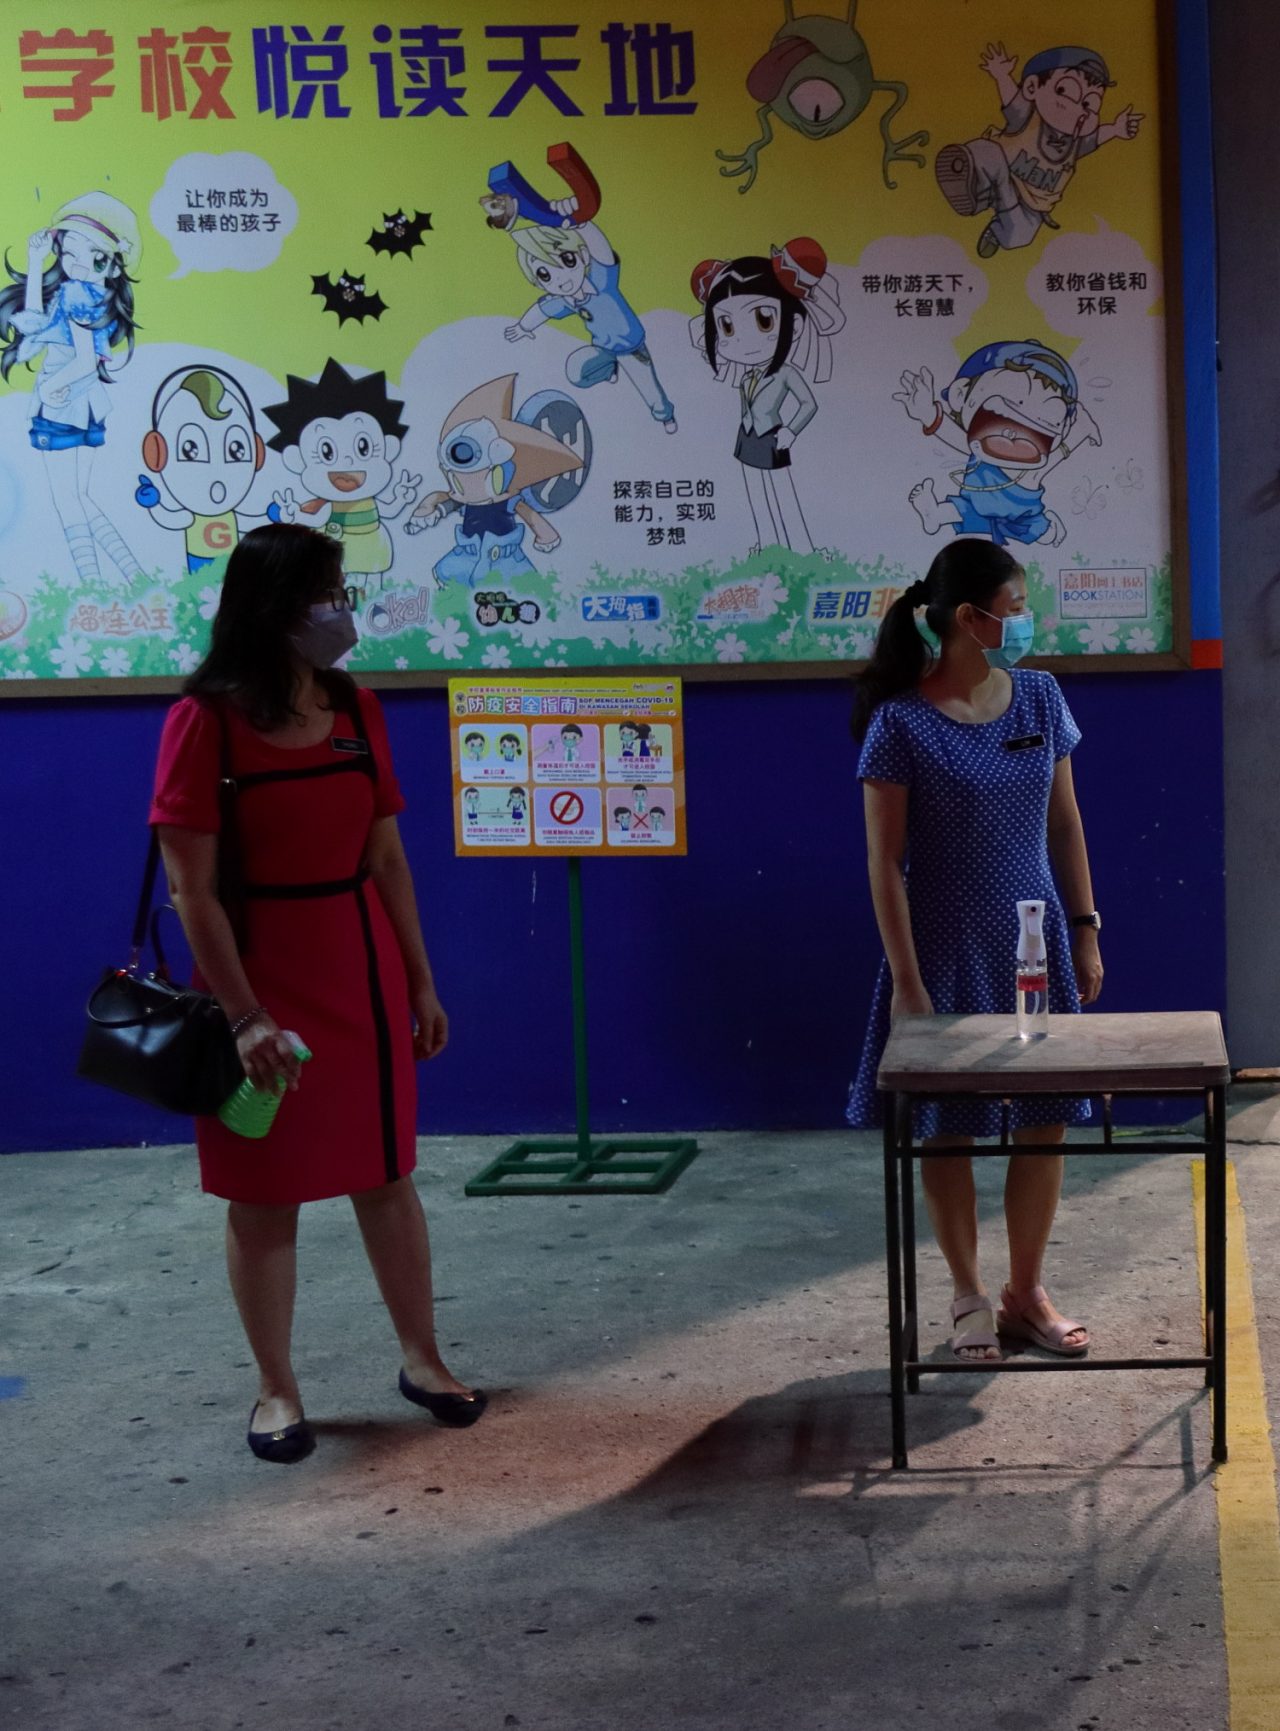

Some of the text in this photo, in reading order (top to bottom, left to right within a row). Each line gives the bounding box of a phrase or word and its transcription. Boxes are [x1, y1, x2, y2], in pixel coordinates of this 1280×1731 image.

[19, 22, 699, 121] 学校悦读天地
[185, 188, 269, 209] 让你成为
[176, 212, 281, 233] 最棒的孩子
[1046, 272, 1148, 293] 教你省钱和
[895, 298, 955, 318] 长智慧
[1077, 296, 1118, 316] 环保
[613, 479, 715, 500] 探索自己的
[203, 522, 232, 549] G
[646, 528, 686, 547] 梦想
[467, 696, 576, 713] 防疫安全指南
